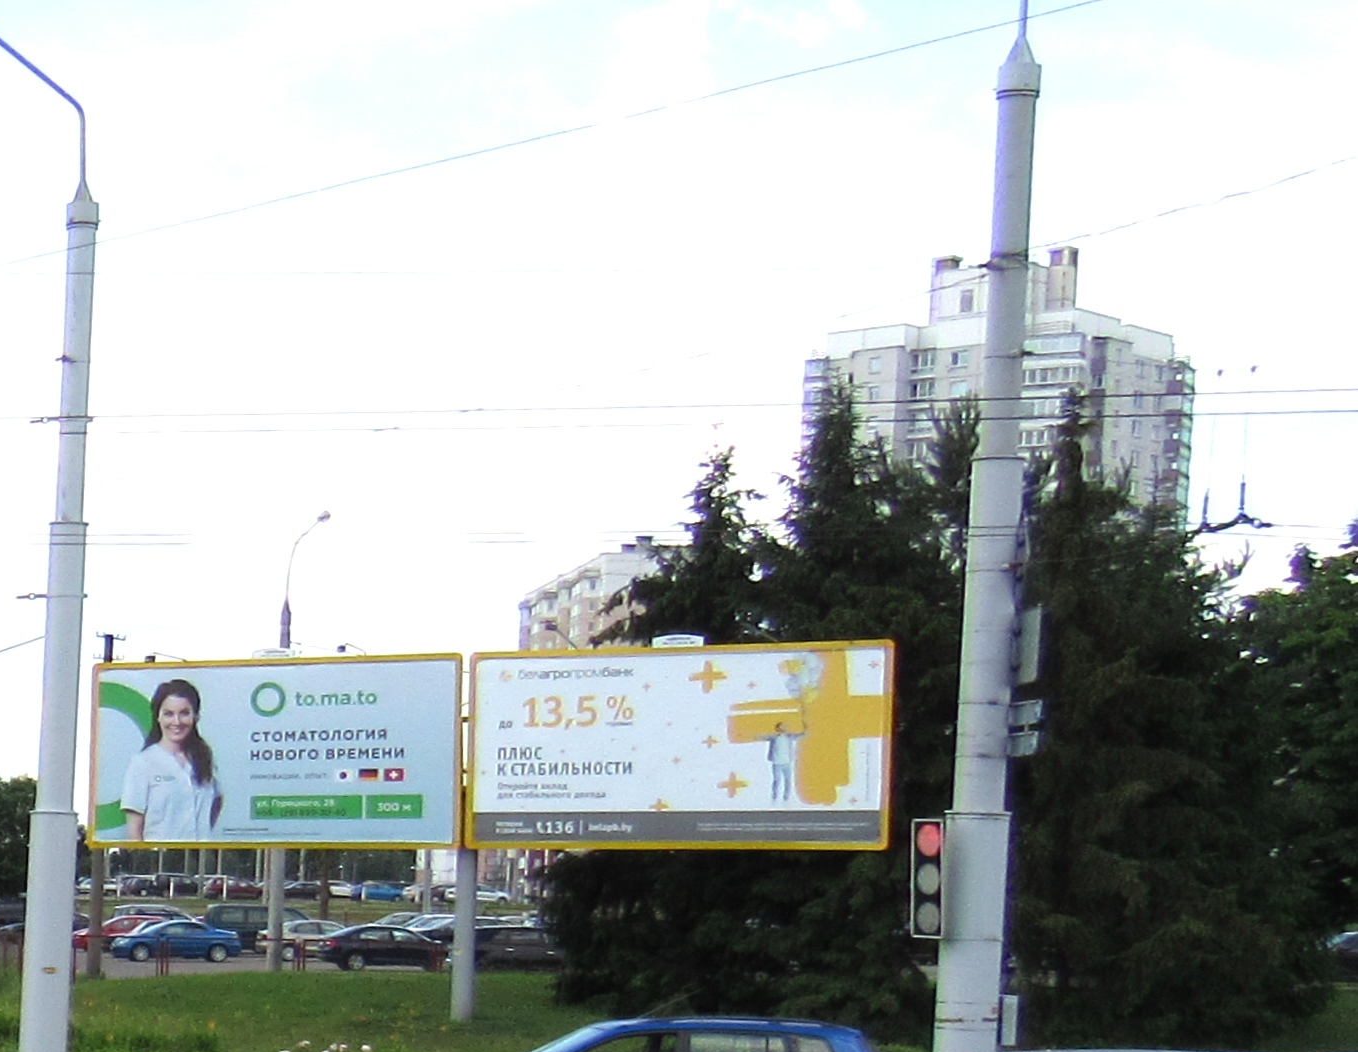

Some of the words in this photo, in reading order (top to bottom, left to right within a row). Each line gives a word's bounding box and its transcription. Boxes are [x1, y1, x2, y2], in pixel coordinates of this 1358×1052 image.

[295, 690, 378, 707] to.ma.to
[522, 695, 598, 730] 13,5
[498, 720, 513, 730] до
[250, 729, 387, 743] СТОМАТОЛОГИЯ
[250, 748, 319, 762] НОВОГО
[325, 747, 405, 760] ВРЕМЕНИ
[497, 746, 543, 760] ПЛЮС
[497, 763, 506, 776] К
[511, 761, 633, 776] СТАБИЛЬНОСТИ
[377, 802, 400, 812] 300
[545, 821, 574, 834] 136
